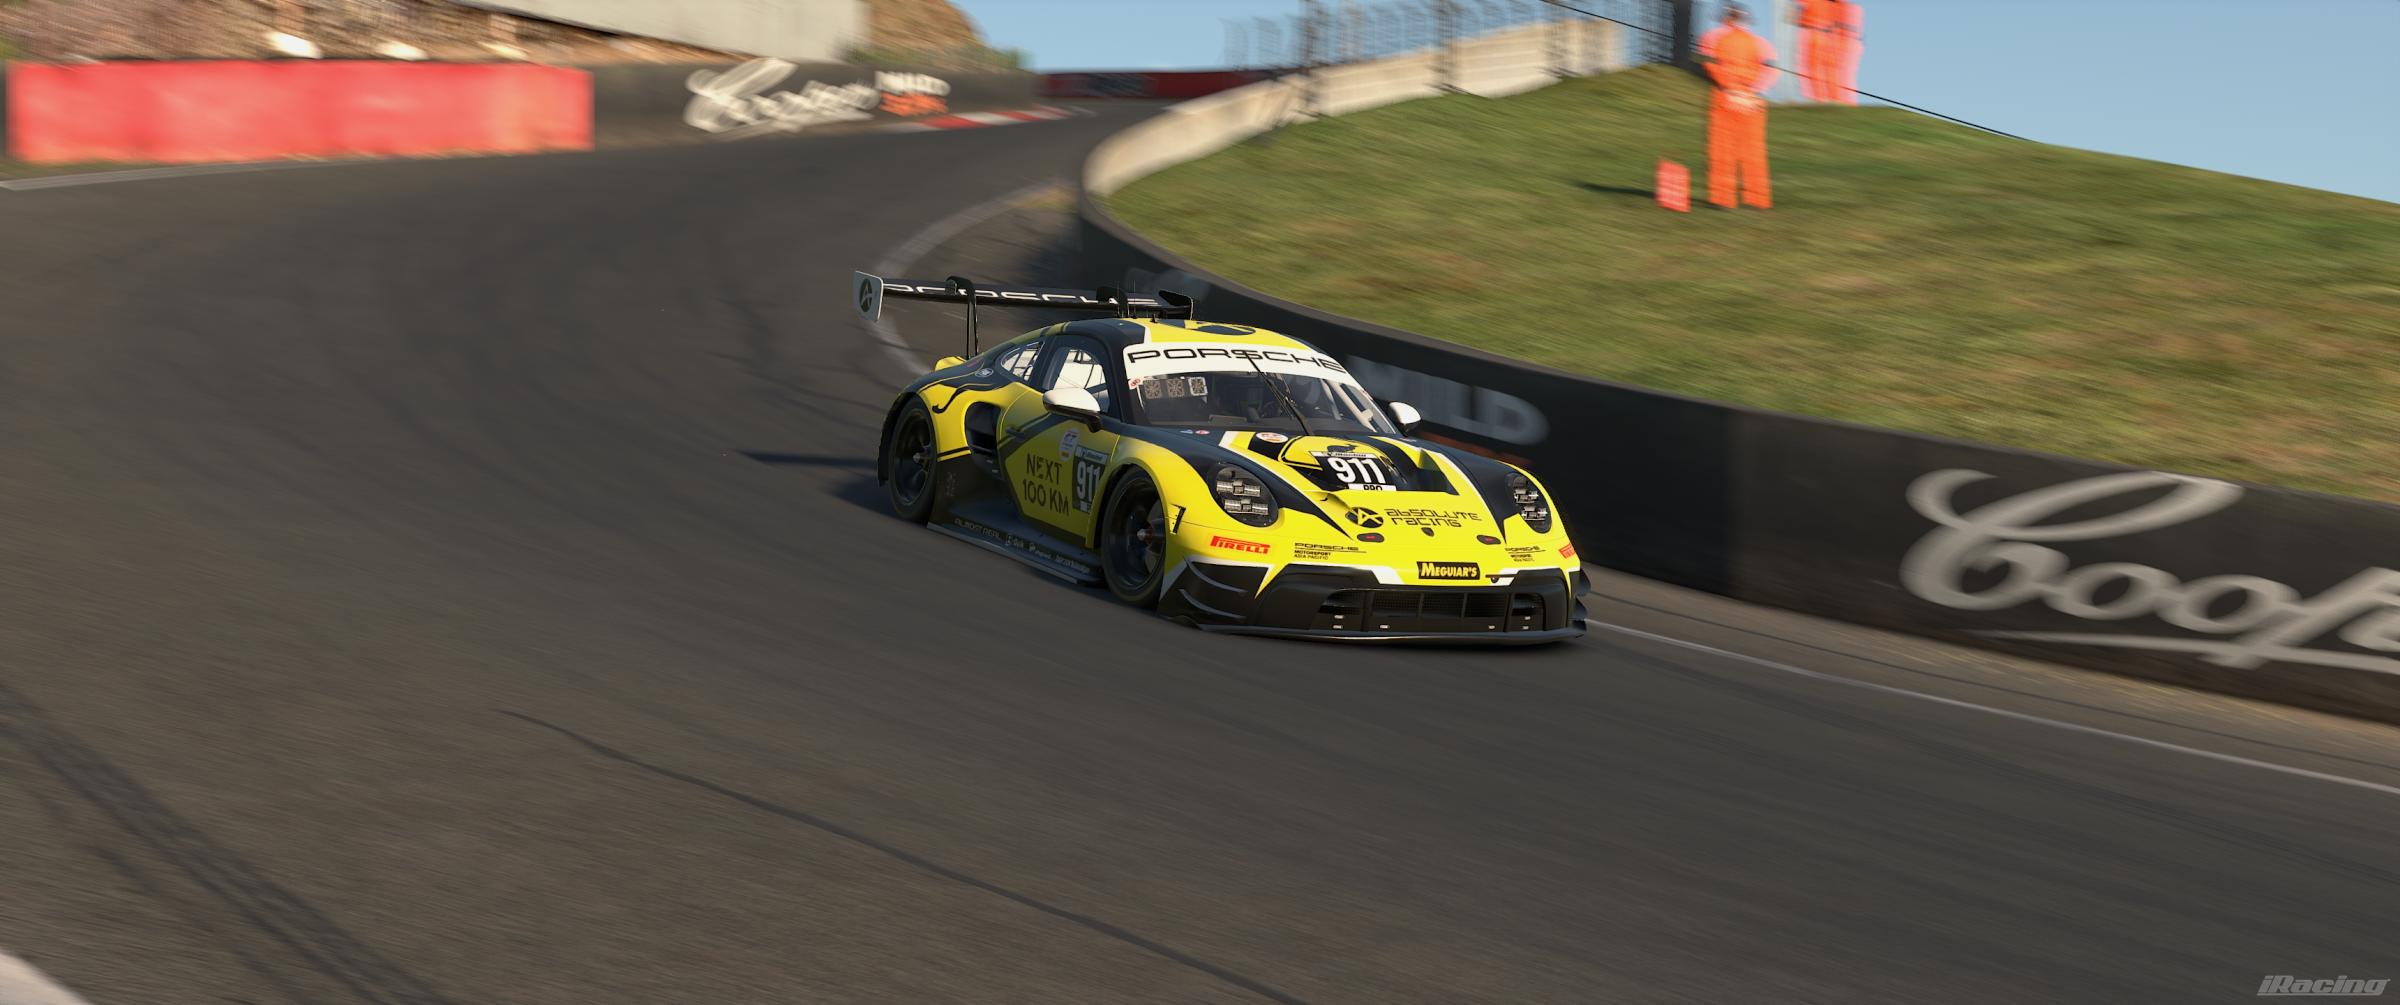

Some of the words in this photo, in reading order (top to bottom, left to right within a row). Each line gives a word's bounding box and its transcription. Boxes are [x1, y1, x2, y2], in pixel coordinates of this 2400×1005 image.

[1128, 348, 1347, 374] PORSCHE
[1026, 452, 1062, 485] NEXT
[1077, 460, 1101, 502] 911
[1327, 457, 1387, 484] 911
[1023, 478, 1046, 507] 100
[1049, 487, 1070, 517] KM
[1210, 535, 1271, 555] PIRELLI
[1294, 542, 1359, 551] PORSCHE
